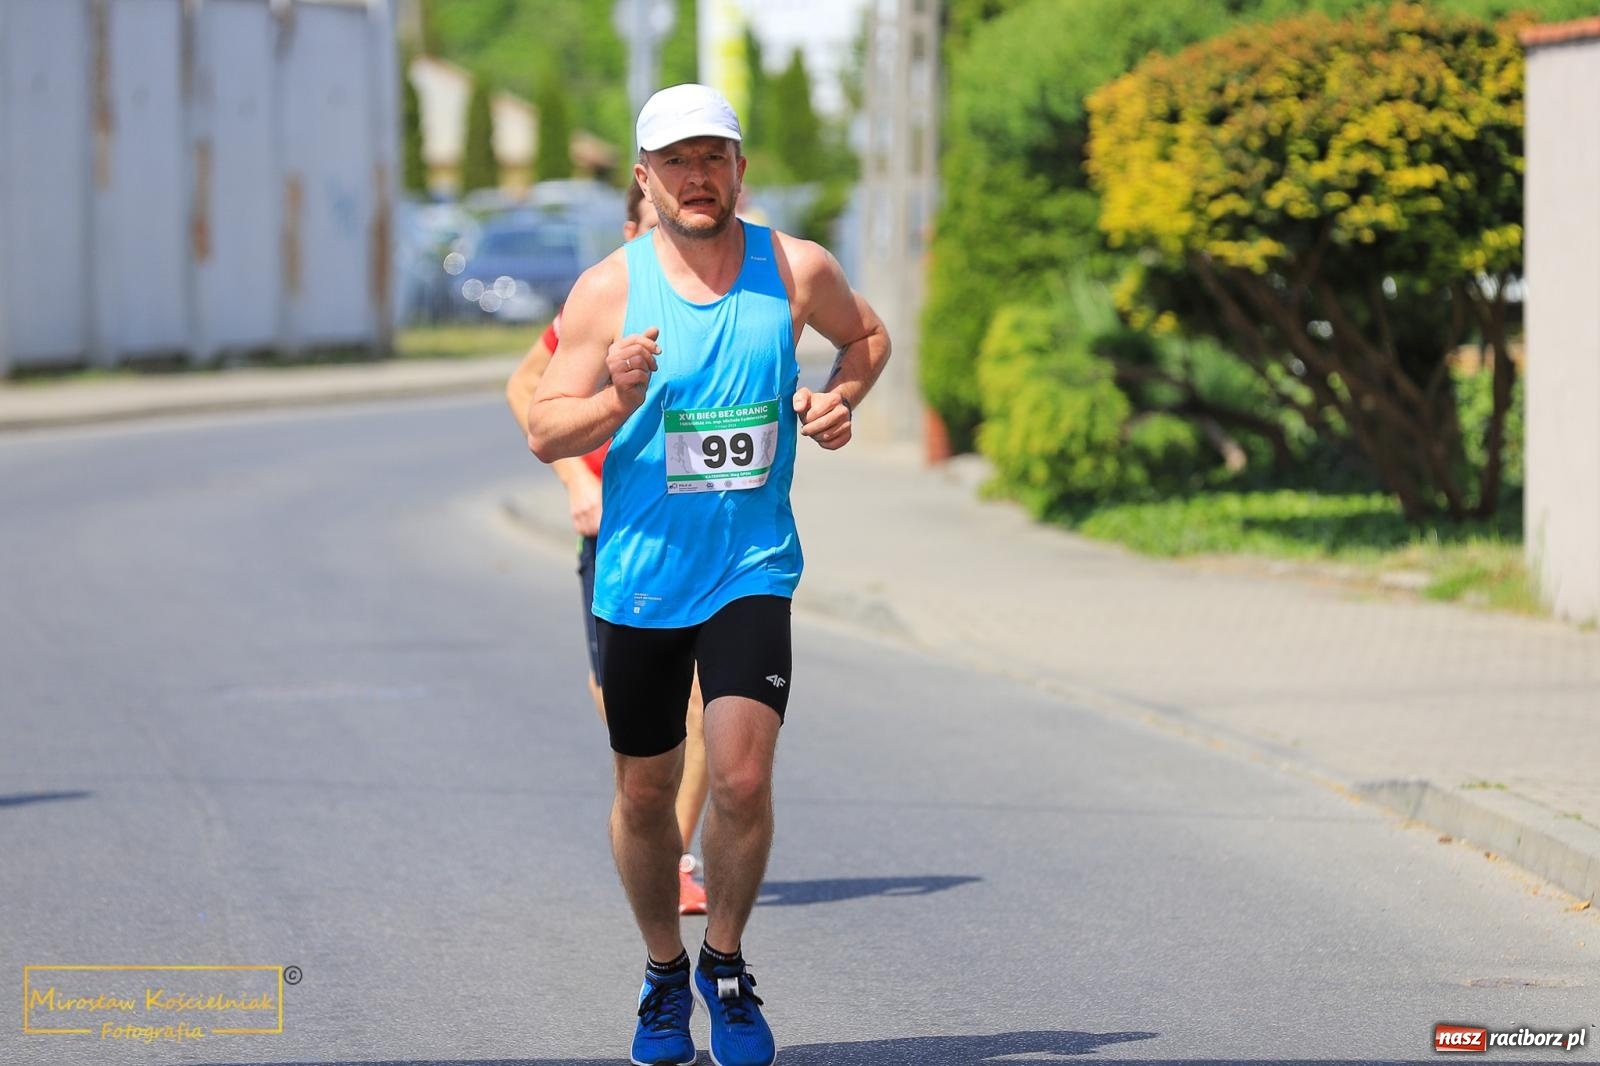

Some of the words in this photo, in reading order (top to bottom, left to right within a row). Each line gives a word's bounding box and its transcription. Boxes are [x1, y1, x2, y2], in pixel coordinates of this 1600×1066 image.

[679, 412, 695, 421] XVI
[696, 411, 717, 420] BIEG
[718, 409, 735, 418] BEZ
[735, 405, 769, 416] GRANIC
[702, 432, 754, 469] 99
[765, 674, 786, 688] 4F
